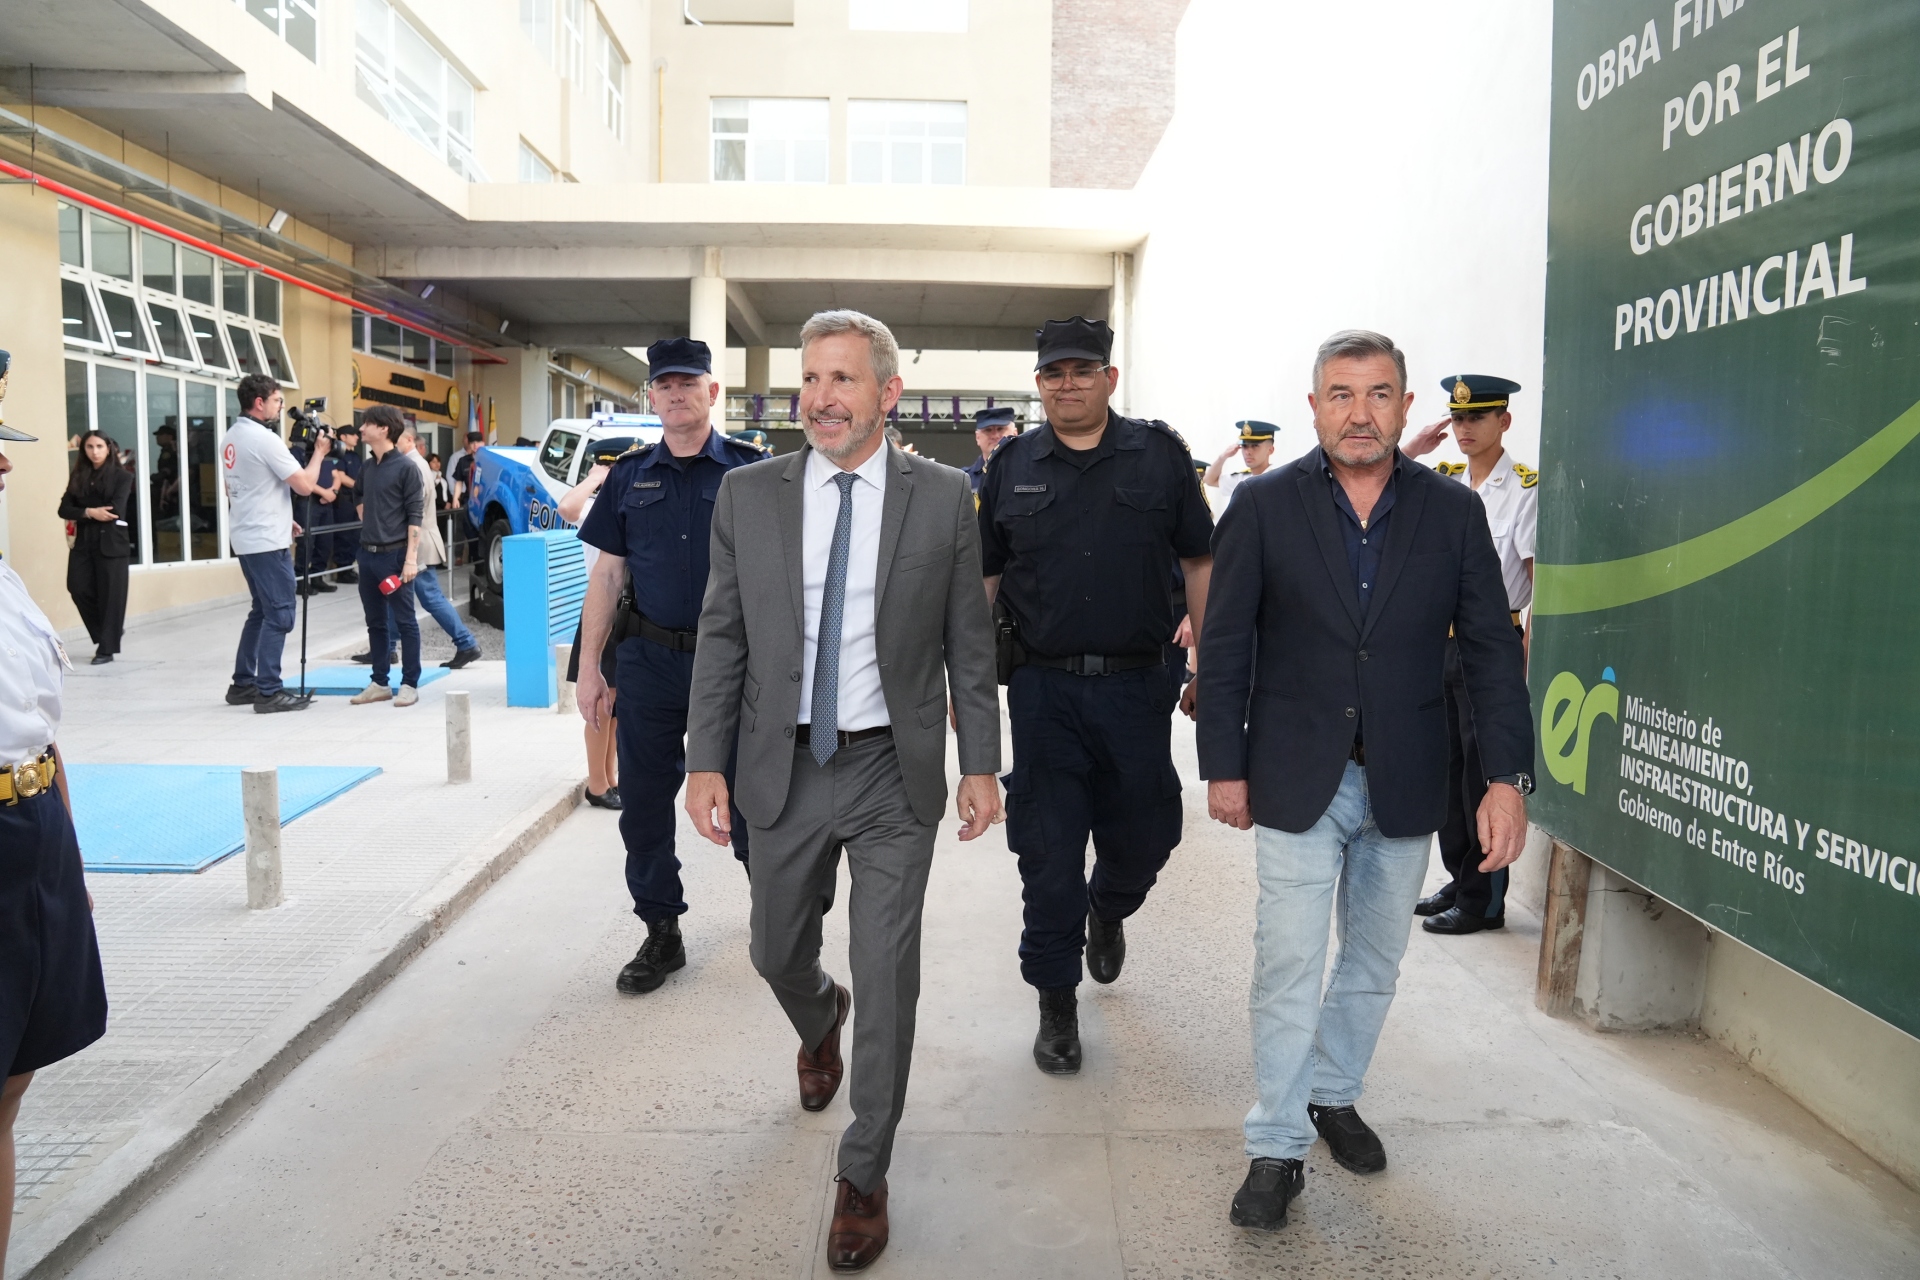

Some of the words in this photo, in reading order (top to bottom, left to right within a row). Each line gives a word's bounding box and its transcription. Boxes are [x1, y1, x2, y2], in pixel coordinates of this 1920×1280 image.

[1577, 19, 1661, 111] OBRA
[1672, 0, 1745, 51] FIN
[1663, 64, 1741, 151] POR
[1756, 26, 1810, 103] EL
[1630, 118, 1853, 255] GOBIERNO
[1615, 233, 1866, 350] PROVINCIAL
[1622, 722, 1753, 796] PLANEAMIENTO,
[1625, 695, 1697, 740] Ministerio
[1701, 717, 1722, 748] de
[1618, 789, 1682, 838] Gobierno
[1687, 818, 1706, 849] de
[1711, 828, 1757, 873] Entre
[1763, 851, 1805, 895] Ríos
[1620, 753, 1788, 845] INSFRAESTRUCTURA
[1794, 819, 1810, 851] Y
[1816, 828, 1920, 897] SERVICI
